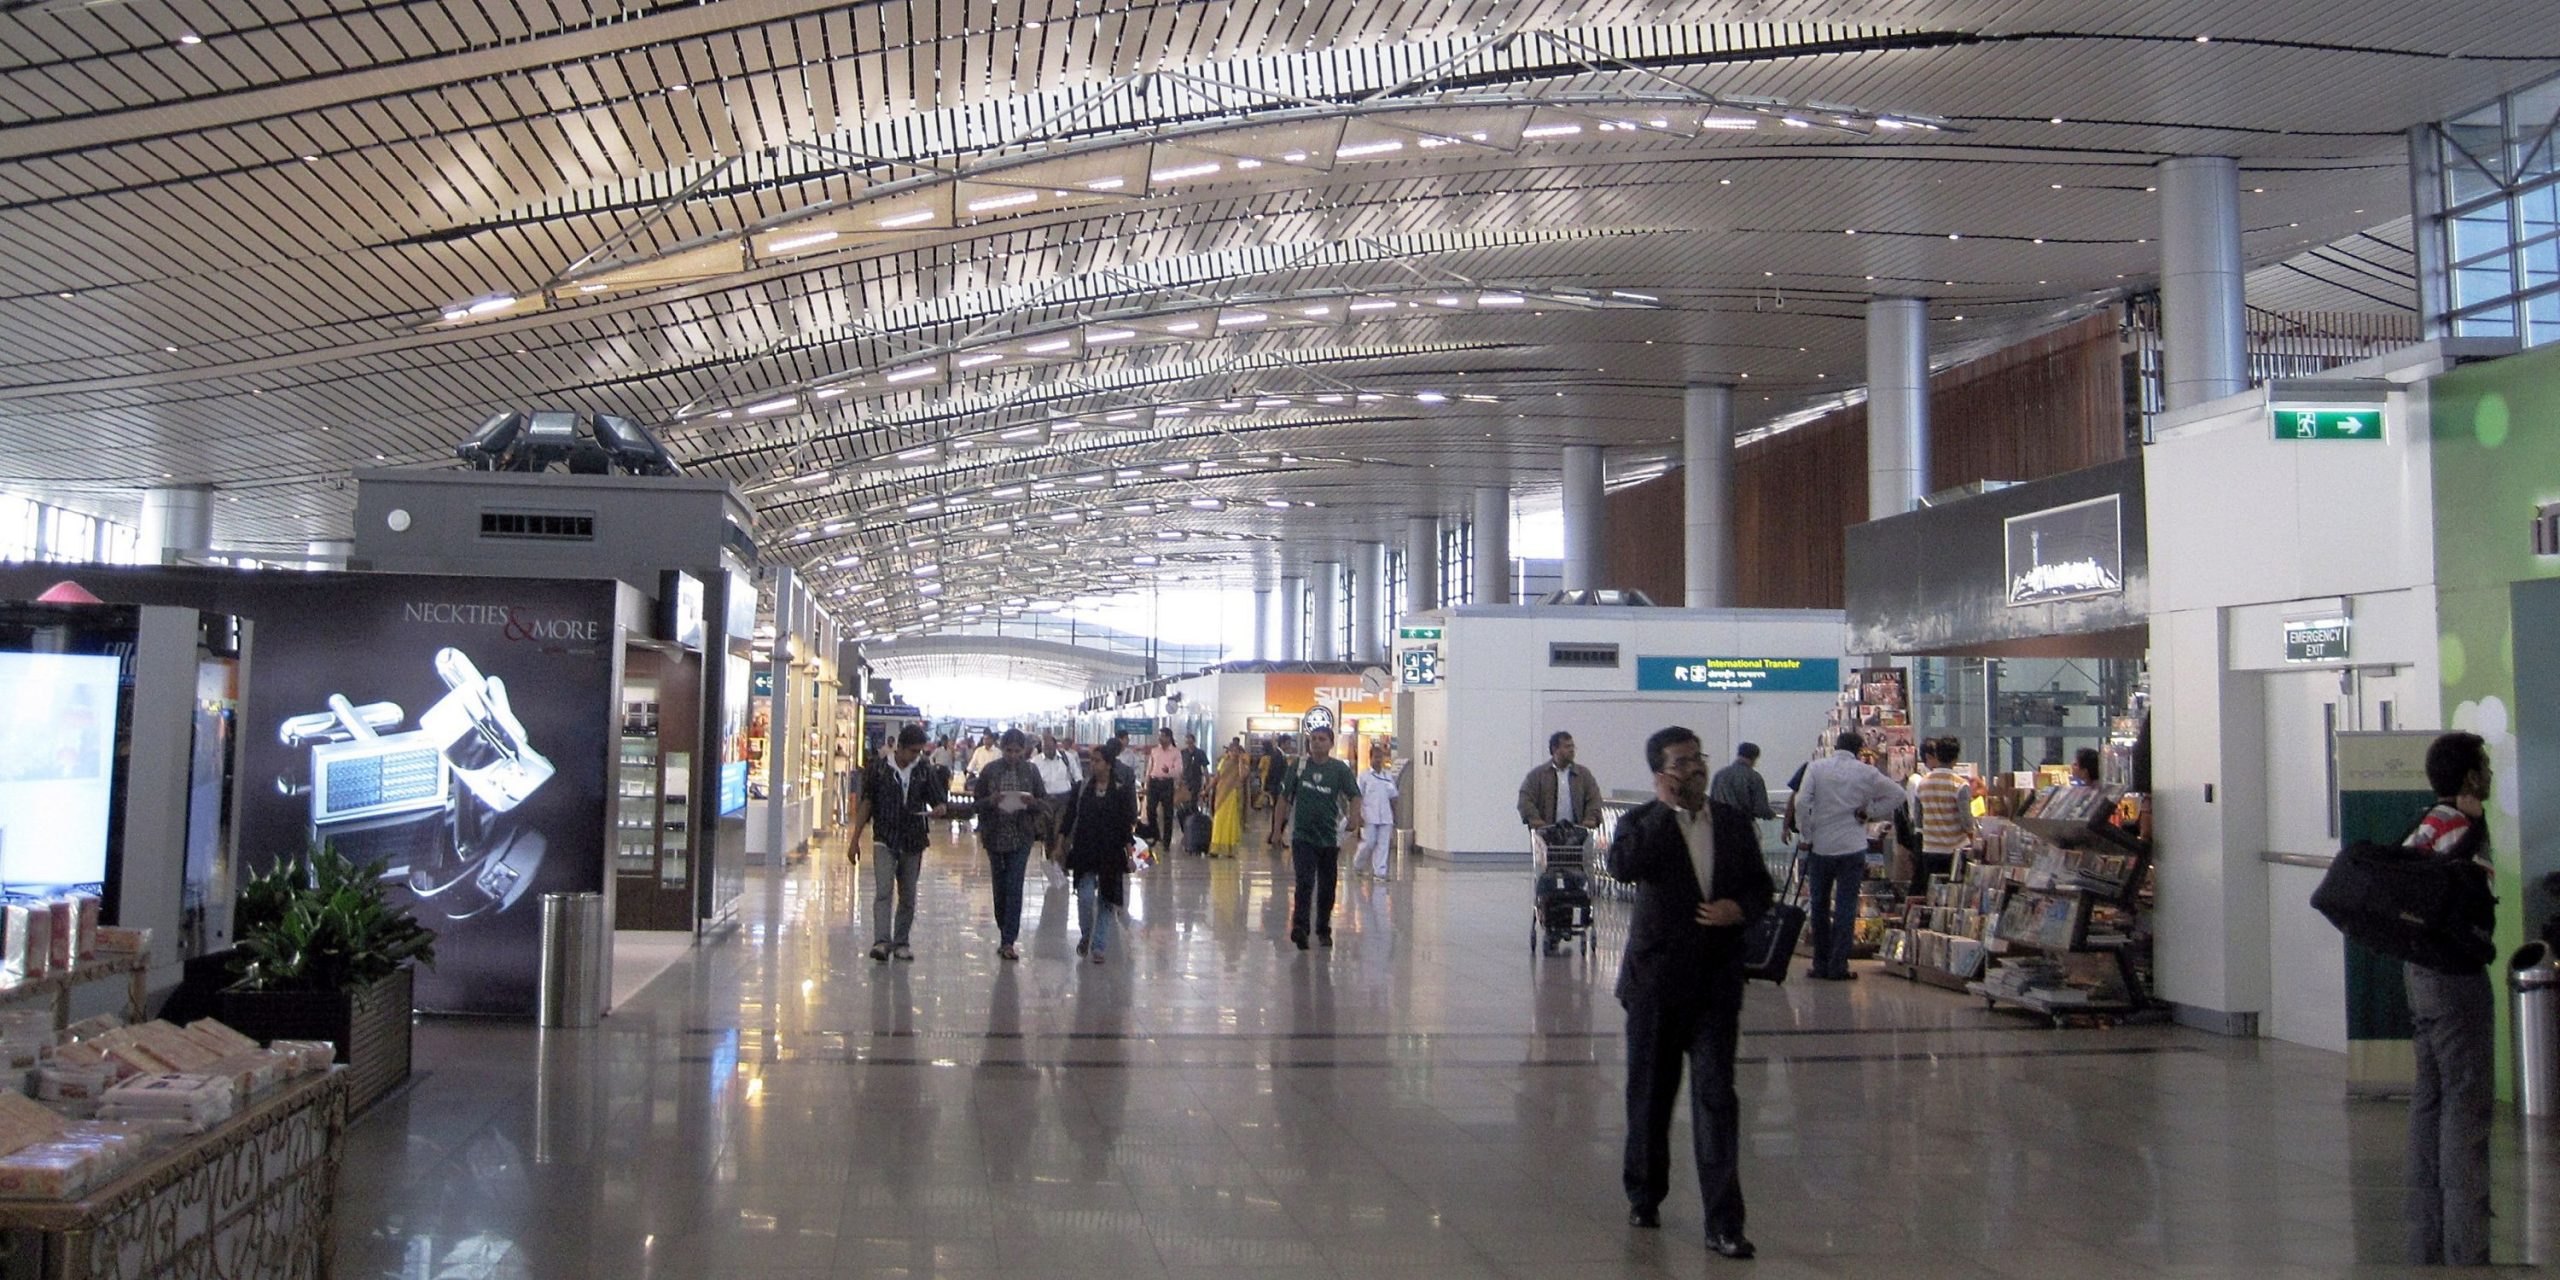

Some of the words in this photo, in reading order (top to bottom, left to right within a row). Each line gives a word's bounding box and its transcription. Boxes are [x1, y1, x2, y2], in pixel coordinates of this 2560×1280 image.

[404, 603, 508, 624] NECKTIES
[533, 620, 598, 640] MORE
[2290, 628, 2341, 643] EMERGENCY
[2306, 643, 2325, 657] EXIT
[1707, 659, 1763, 668] International
[1764, 659, 1800, 668] Transfer
